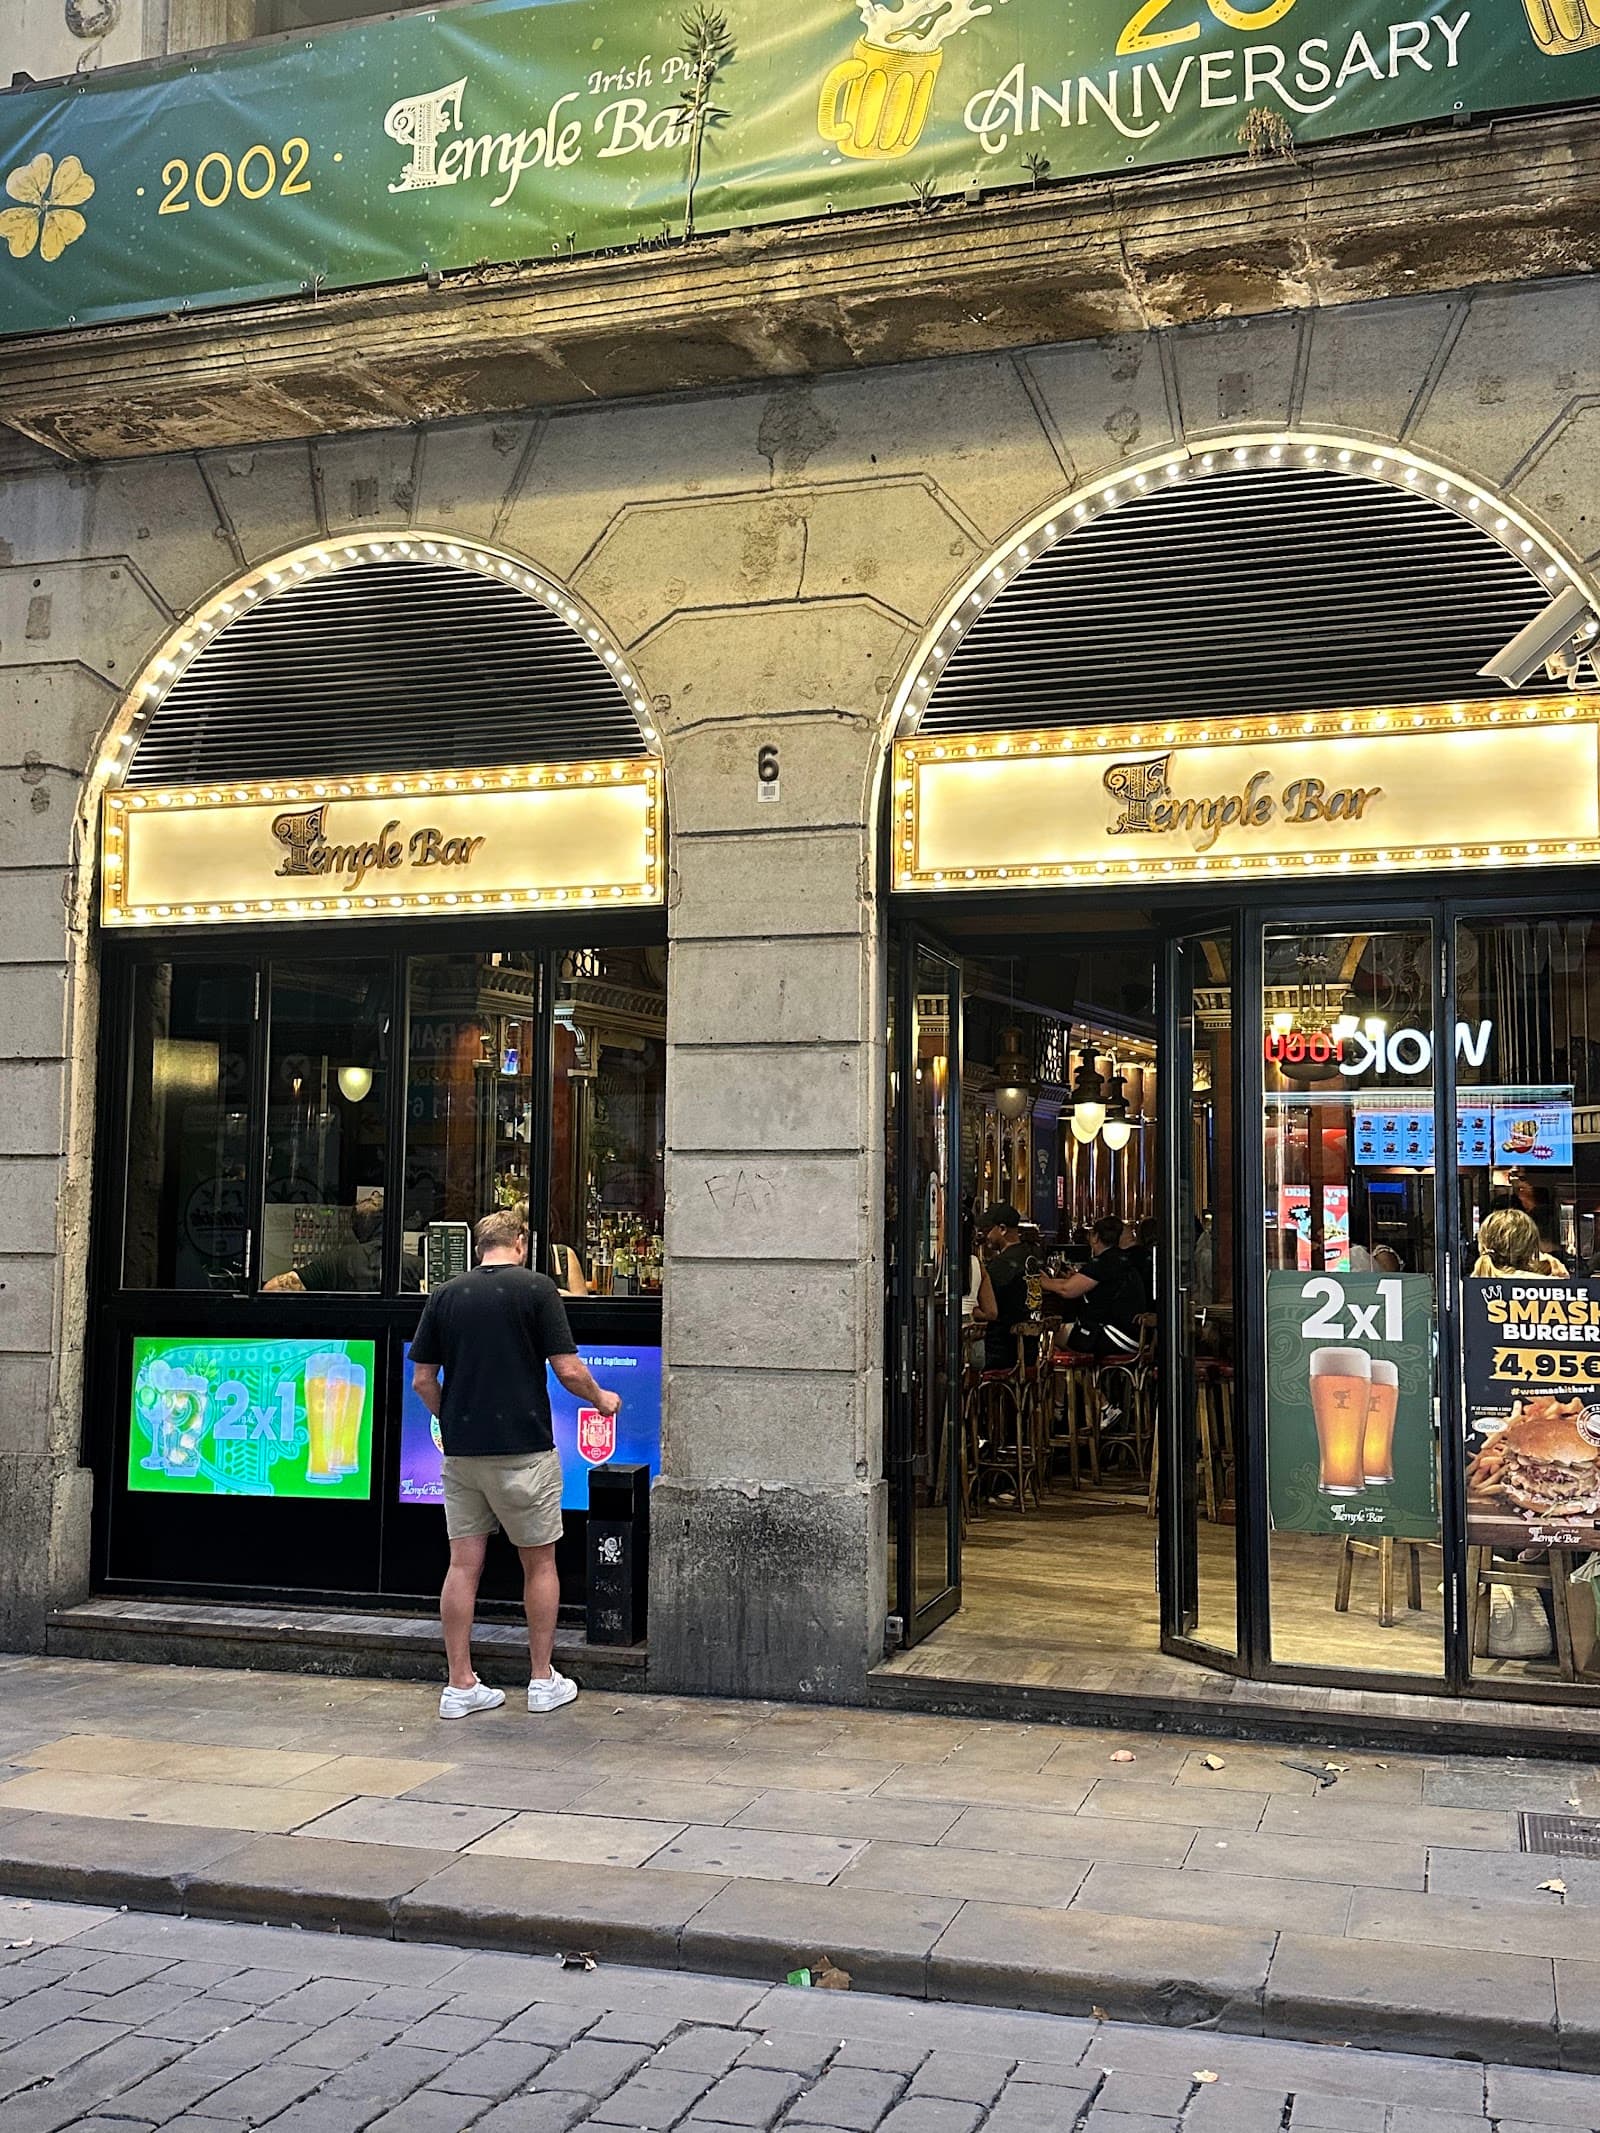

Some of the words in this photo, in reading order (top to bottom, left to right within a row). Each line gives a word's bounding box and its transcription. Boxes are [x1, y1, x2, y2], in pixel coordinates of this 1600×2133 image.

[588, 54, 653, 95] Irish
[661, 56, 717, 84] Pu
[964, 11, 1470, 154] ANNIVERSARY
[384, 77, 582, 206] Temple
[594, 98, 714, 158] Bar
[157, 137, 311, 215] 2002
[758, 745, 779, 782] 6
[1103, 751, 1272, 852] Temple
[1284, 777, 1384, 824] Bar
[271, 803, 402, 891] Temple
[411, 827, 485, 868] Bar
[1301, 1277, 1403, 1341] 2x1
[1512, 1287, 1588, 1301] DOUBLE
[1503, 1324, 1600, 1341] BURGER
[1499, 1354, 1600, 1382] 4,95€
[213, 1380, 296, 1441] 2x1
[401, 1479, 428, 1499] Temple
[1331, 1504, 1365, 1526] Temple
[1366, 1512, 1386, 1522] Bar
[1529, 1526, 1562, 1547] Temple
[1563, 1534, 1581, 1544] Bar
